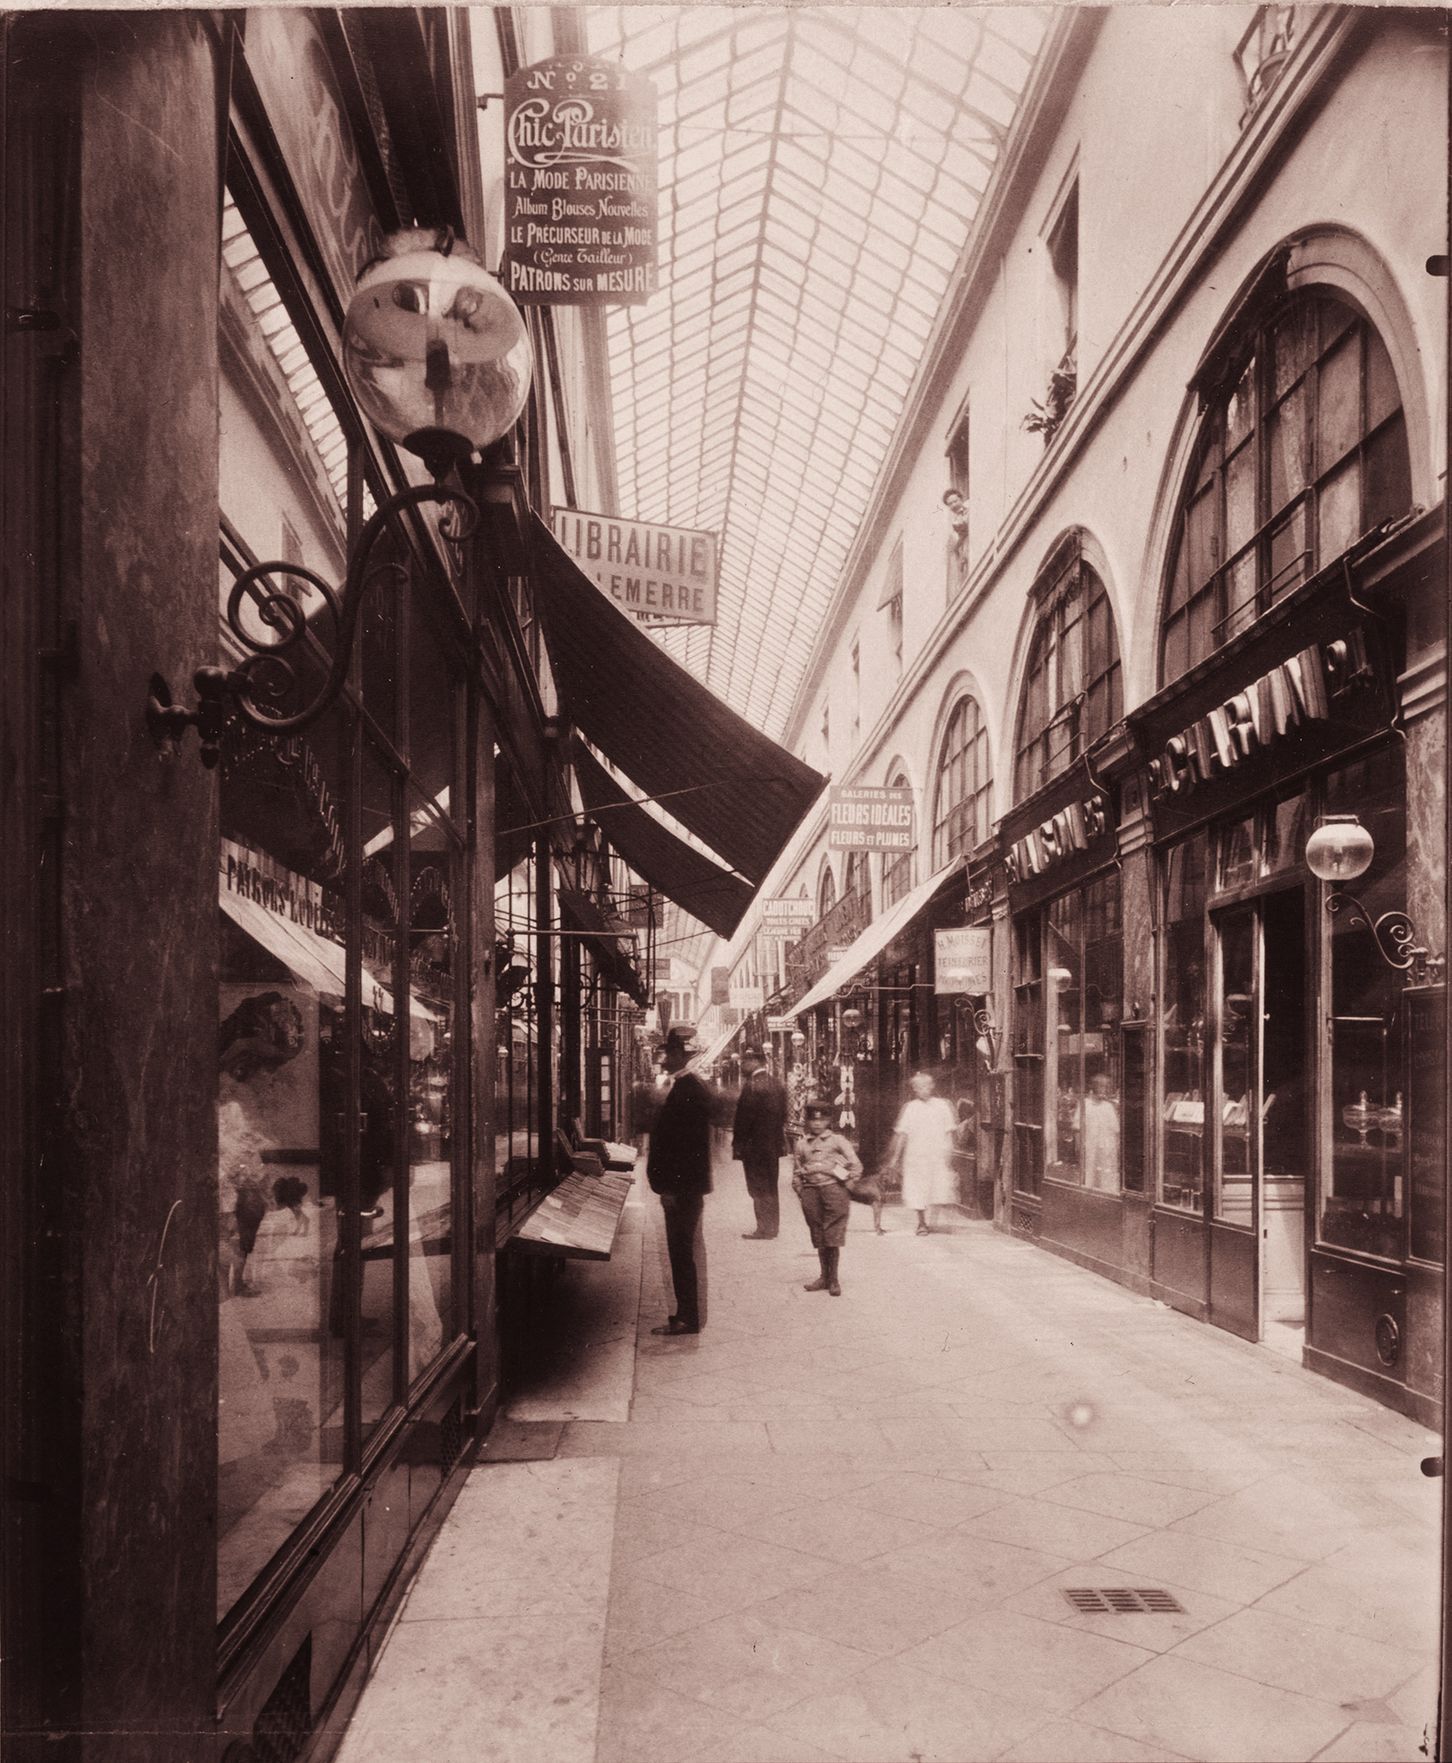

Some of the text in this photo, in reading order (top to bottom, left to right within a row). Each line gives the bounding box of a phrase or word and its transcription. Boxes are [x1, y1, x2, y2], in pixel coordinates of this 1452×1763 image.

[508, 98, 651, 168] Chic Parisien
[510, 166, 651, 192] LA MODE PARISIENNE
[512, 195, 648, 221] Album Blouses Nouvelles
[511, 223, 652, 248] LE PRÉCURSEUR DE LA MODE
[577, 249, 633, 266] Tailleur)
[510, 261, 652, 291] PATRONS SUR MESURE
[561, 516, 708, 577] LIBRAIRIE
[841, 790, 887, 799] GALERIES
[831, 802, 911, 826] FLEURS IDÉALES
[831, 831, 910, 847] FLEURS ET PLUMES
